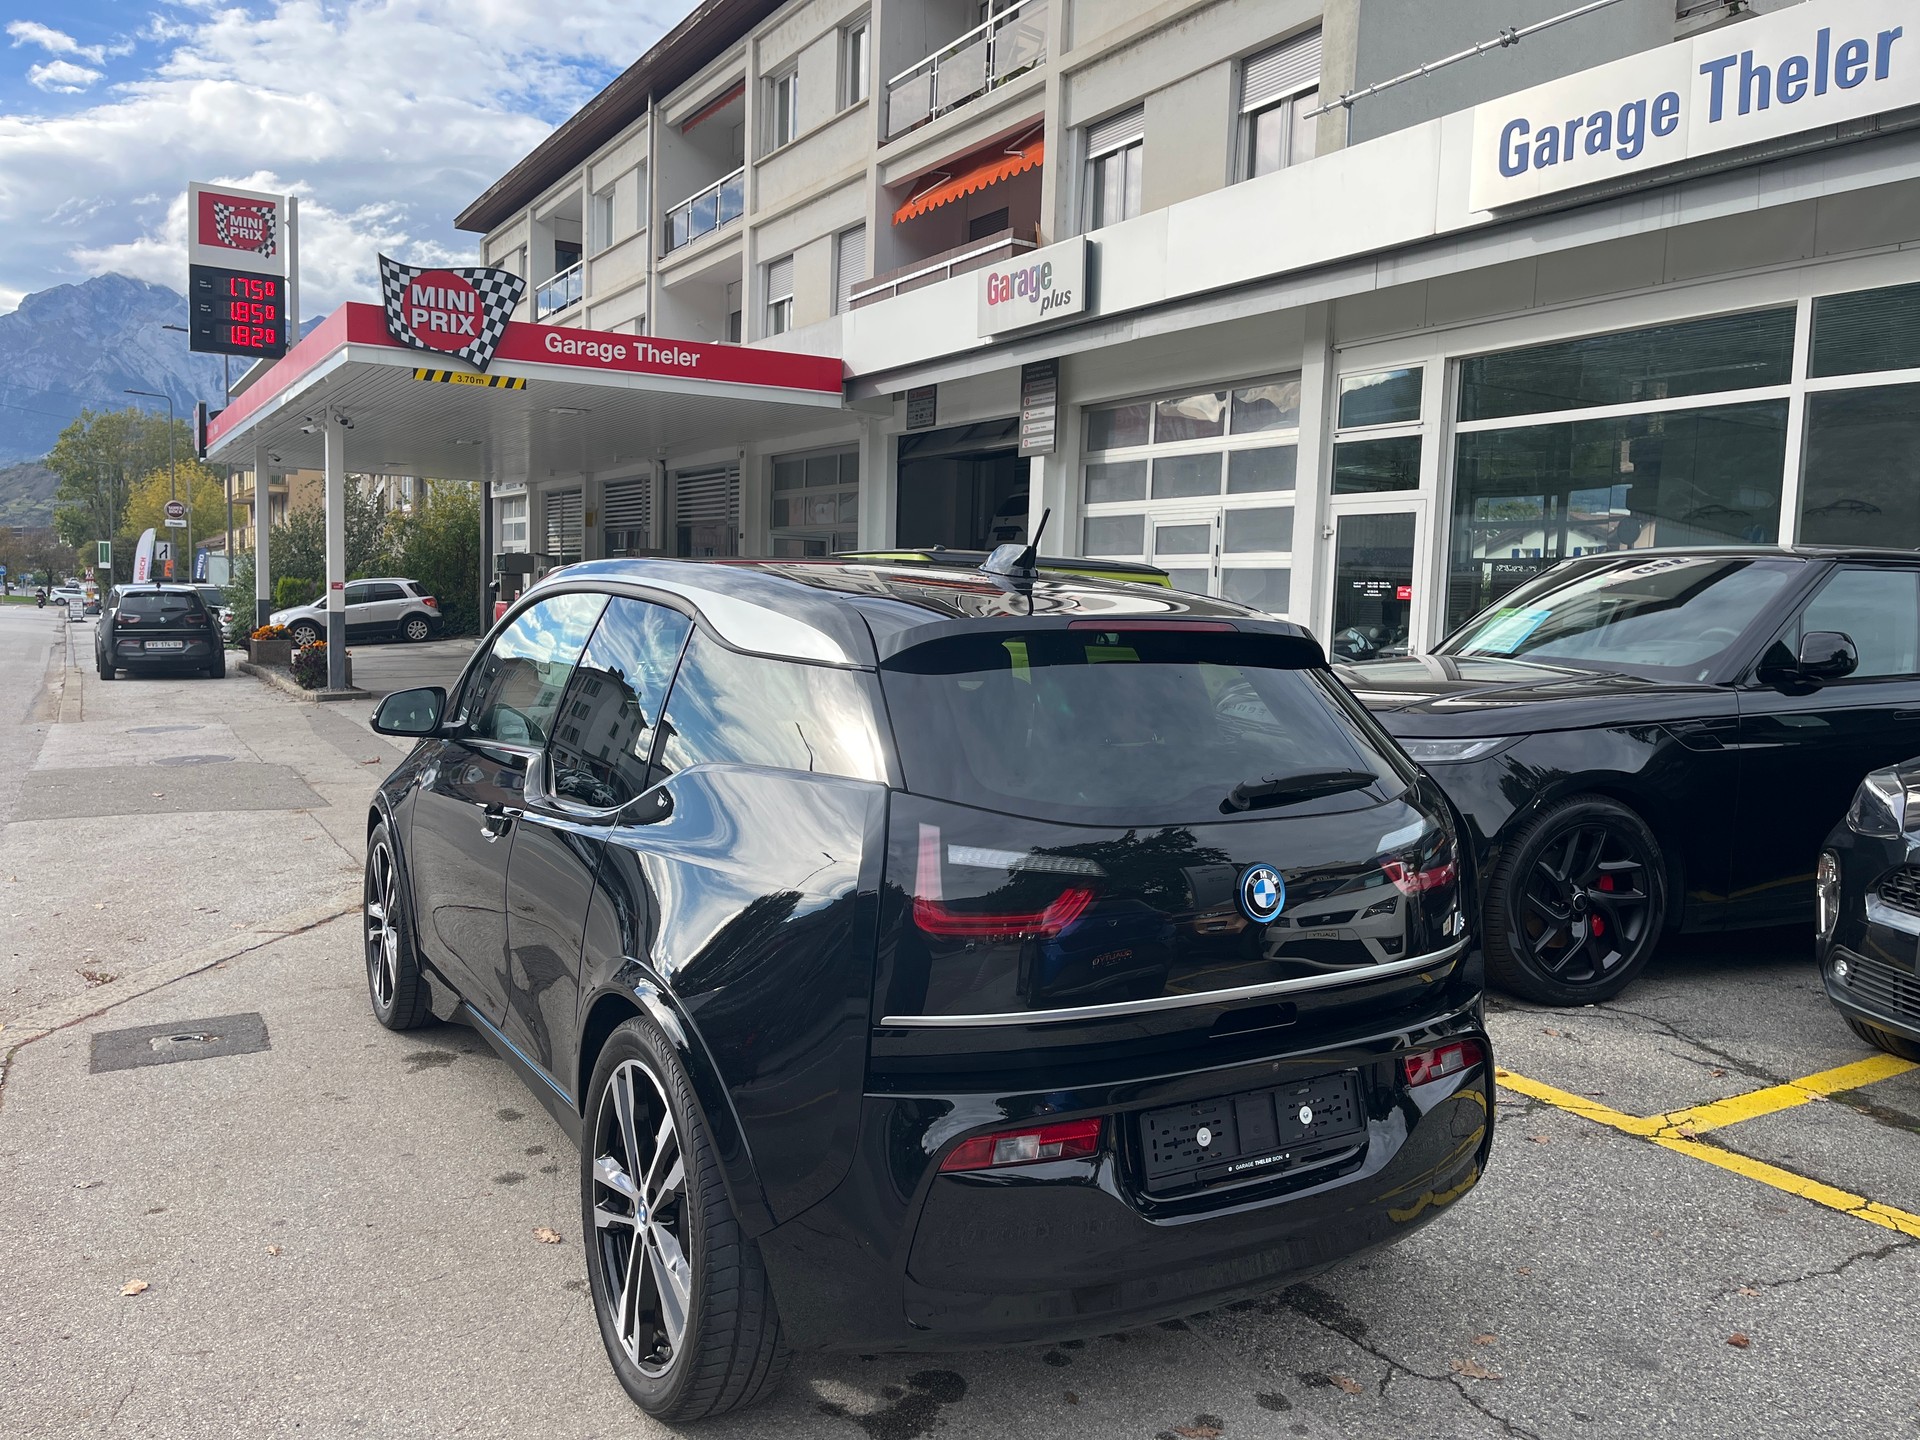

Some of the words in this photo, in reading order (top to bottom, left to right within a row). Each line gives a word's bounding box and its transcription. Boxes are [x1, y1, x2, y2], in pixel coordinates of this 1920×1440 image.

[1498, 91, 1680, 178] Garage
[1699, 25, 1903, 124] Theler
[230, 214, 263, 230] MINI
[230, 226, 263, 241] PRIX
[987, 261, 1053, 305] Garage
[411, 284, 475, 313] MINI
[1040, 289, 1072, 316] plus
[411, 308, 476, 337] PRIX
[544, 333, 627, 363] Garage
[633, 342, 701, 367] Theler
[1248, 870, 1280, 887] BMW
[1235, 1161, 1254, 1170] GARAGE
[1254, 1157, 1272, 1166] THELER
